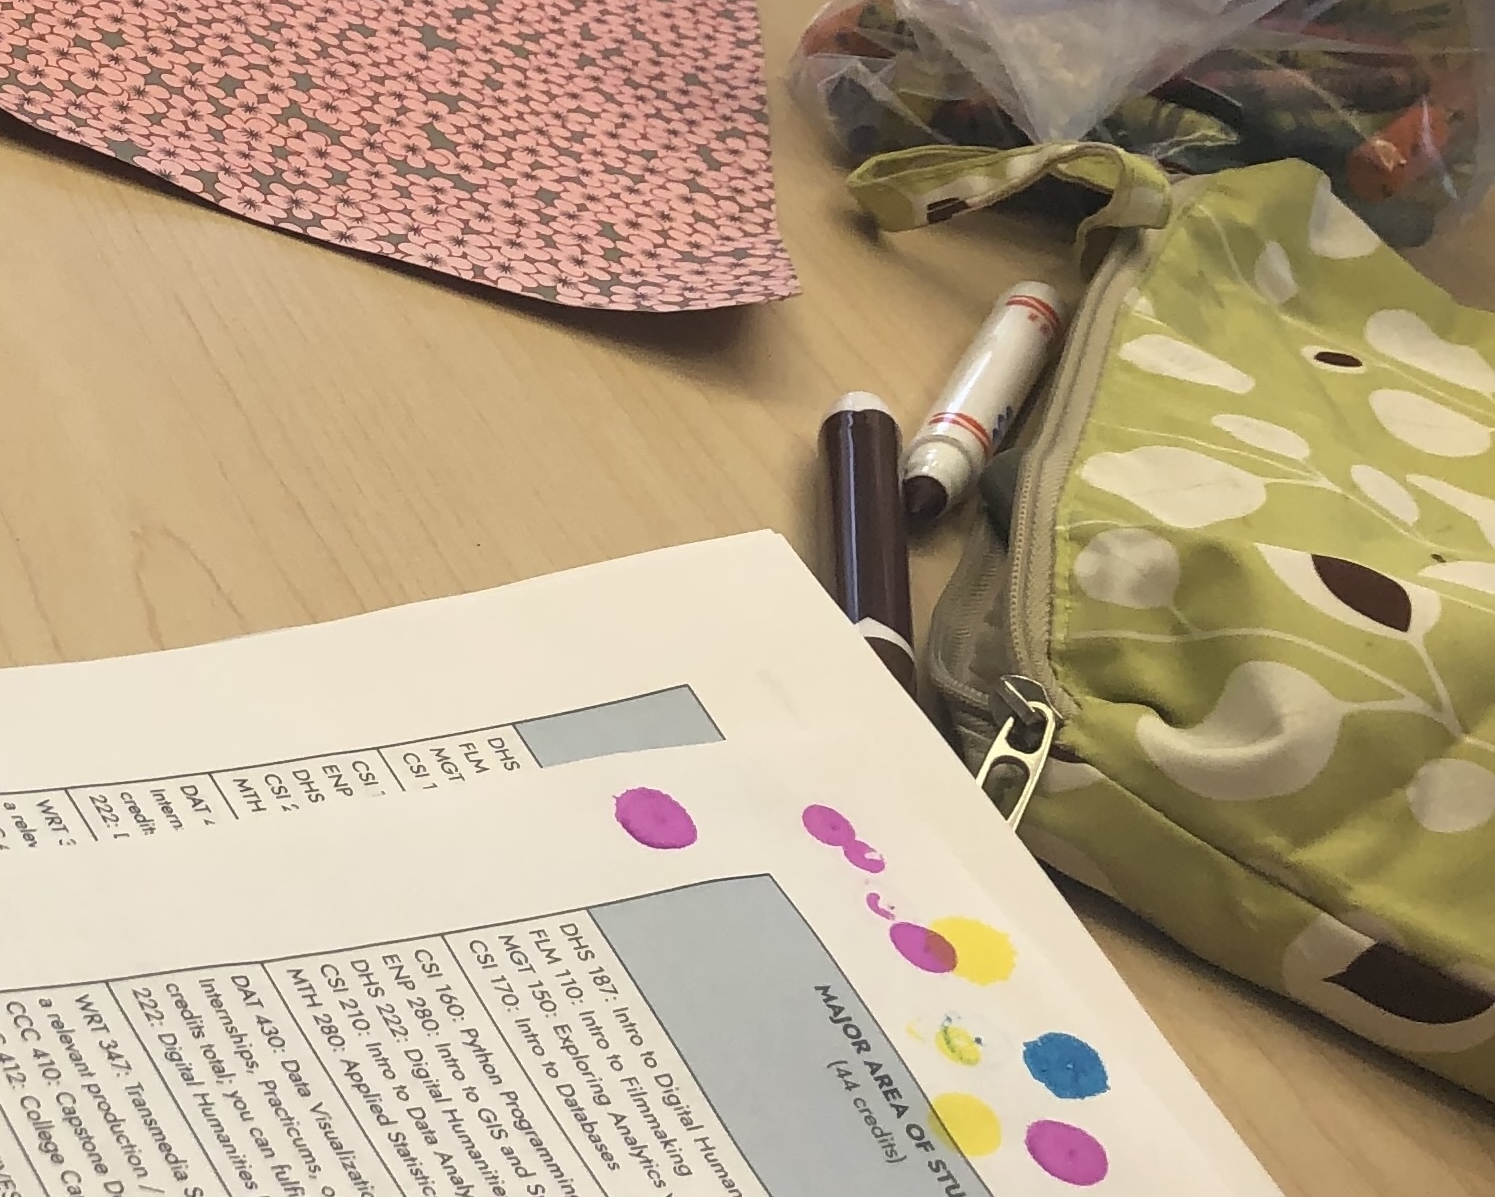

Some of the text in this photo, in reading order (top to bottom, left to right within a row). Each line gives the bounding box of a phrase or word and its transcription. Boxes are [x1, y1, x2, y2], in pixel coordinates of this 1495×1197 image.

[3, 801, 16, 811] a
[36, 799, 69, 834] WRT
[89, 794, 120, 829] 222:
[180, 784, 212, 814] DAT
[233, 778, 267, 813] MTH
[264, 773, 291, 799] CSI
[292, 769, 325, 803] DHS
[322, 764, 354, 797] ENP
[352, 760, 379, 786] CSI
[402, 752, 430, 778] CSI
[430, 748, 465, 782] MGT
[459, 742, 490, 774] FLM
[488, 737, 520, 771] DHS
[38, 998, 52, 1008] a
[47, 1013, 96, 1077] relevant
[81, 1082, 149, 1180] production
[75, 994, 110, 1033] WRT
[99, 1039, 132, 1077] 347:
[124, 1082, 189, 1182] Transmedia
[131, 987, 258, 1190] 222: Digital Humanities
[165, 983, 206, 1040] credits
[200, 1043, 236, 1084] total;
[222, 1090, 255, 1122] you
[249, 1126, 276, 1159] can
[198, 978, 260, 1074] Internships,
[258, 1080, 322, 1180] Practicums,
[231, 975, 265, 1009] DAT
[255, 1014, 286, 1054] 430:
[281, 1059, 312, 1098] Data
[287, 968, 323, 1008] MTH
[312, 1013, 346, 1053] 280:
[339, 1058, 398, 1127] Applied
[320, 963, 349, 993] CSI
[339, 998, 370, 1037] 210:
[365, 1042, 396, 1080] Intro
[393, 1085, 410, 1102] to
[406, 1107, 439, 1146] Data
[350, 959, 385, 999] DHS
[376, 1003, 409, 1043] 222:
[403, 1049, 452, 1104] Digital
[382, 953, 547, 1197] ENP 280: Intro to GIS and S
[414, 948, 579, 1197] CSI 160: Python Programmin
[469, 939, 620, 1172] CSI 170: Intro to Databases
[498, 934, 667, 1189] MGT 150: Exploring Analytics
[529, 929, 693, 1177] FLM 110: Intro to Filmmaking
[559, 923, 596, 962] DHS
[588, 966, 619, 1002] 187:
[613, 1006, 644, 1047] Intro
[640, 1050, 657, 1069] to
[655, 1073, 705, 1132] Digital
[813, 984, 872, 1055] MAJOR
[863, 1060, 910, 1119] AREA
[905, 1123, 936, 1153] OF
[6, 1001, 125, 1197] CCC 410: Capstone D
[19, 1096, 65, 1165] College
[826, 1060, 908, 1164] (44 credits)
